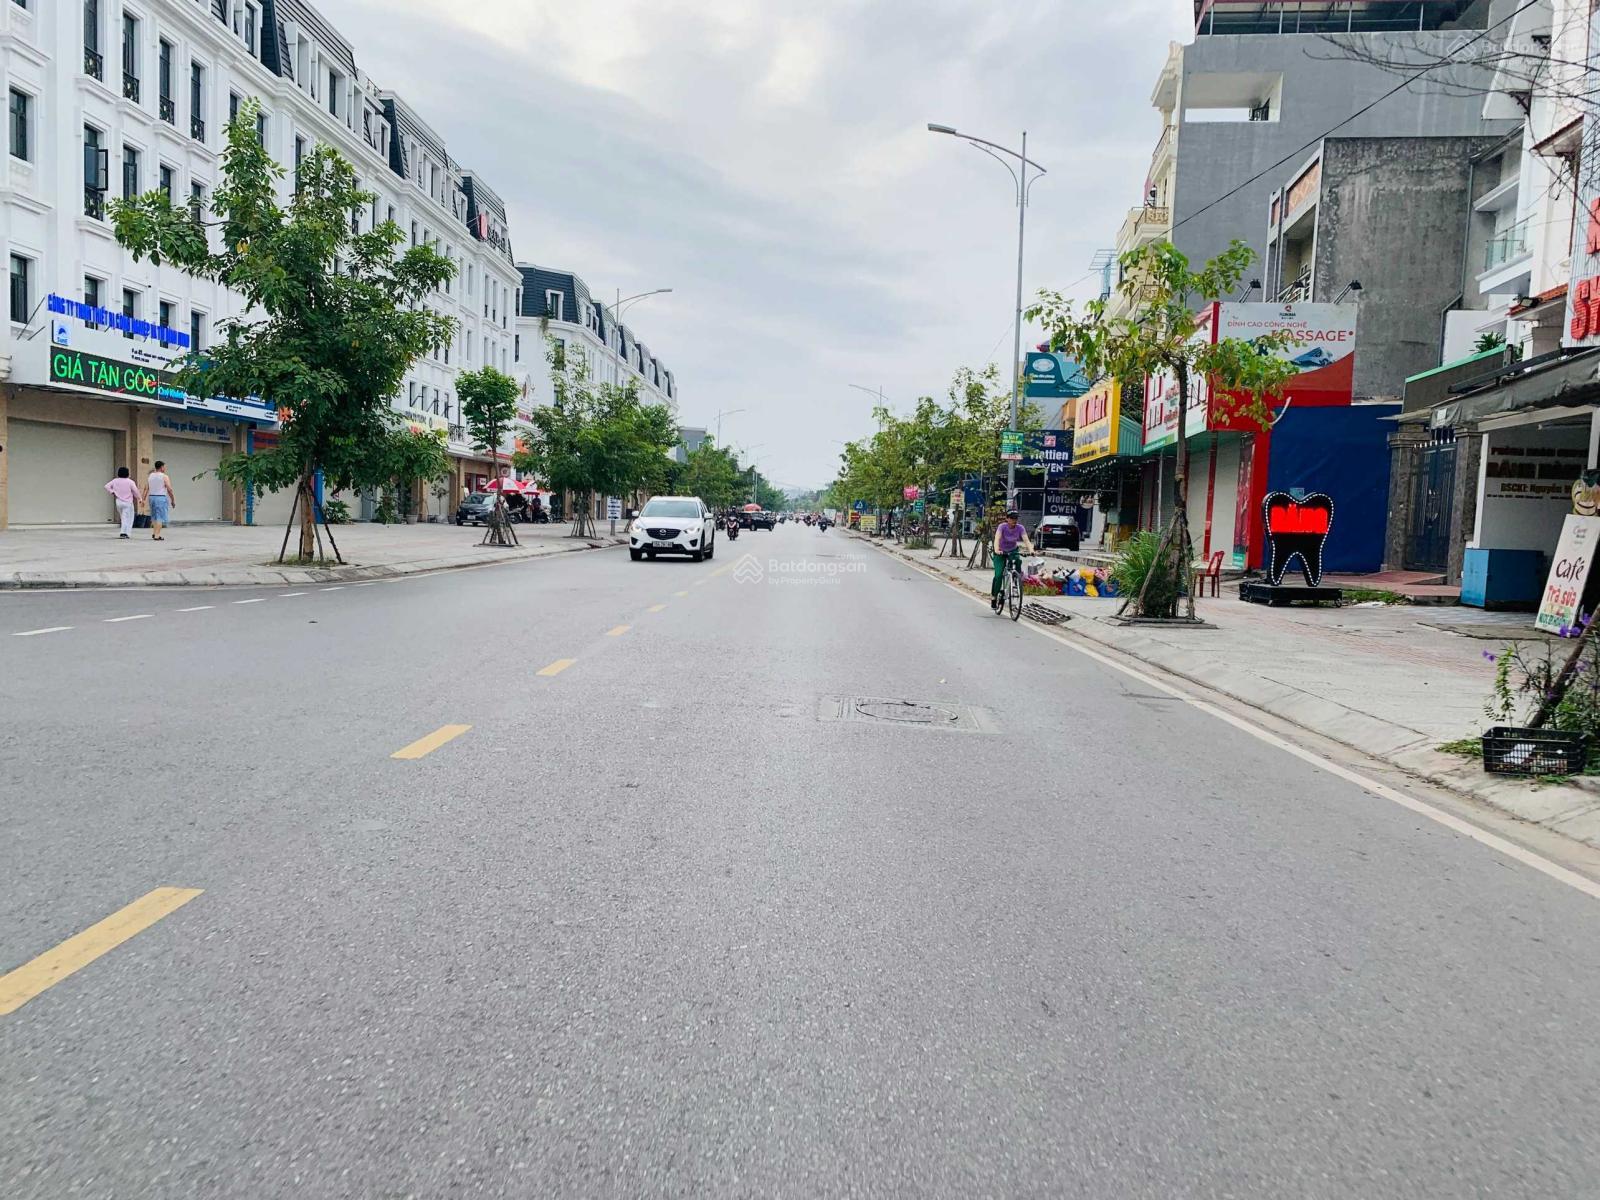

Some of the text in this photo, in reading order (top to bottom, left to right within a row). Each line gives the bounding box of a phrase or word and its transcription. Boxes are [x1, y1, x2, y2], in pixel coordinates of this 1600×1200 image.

[54, 353, 84, 380] GIÁ
[88, 360, 120, 388] TẬN
[1050, 504, 1077, 514] OWEN
[1556, 557, 1585, 582] Café
